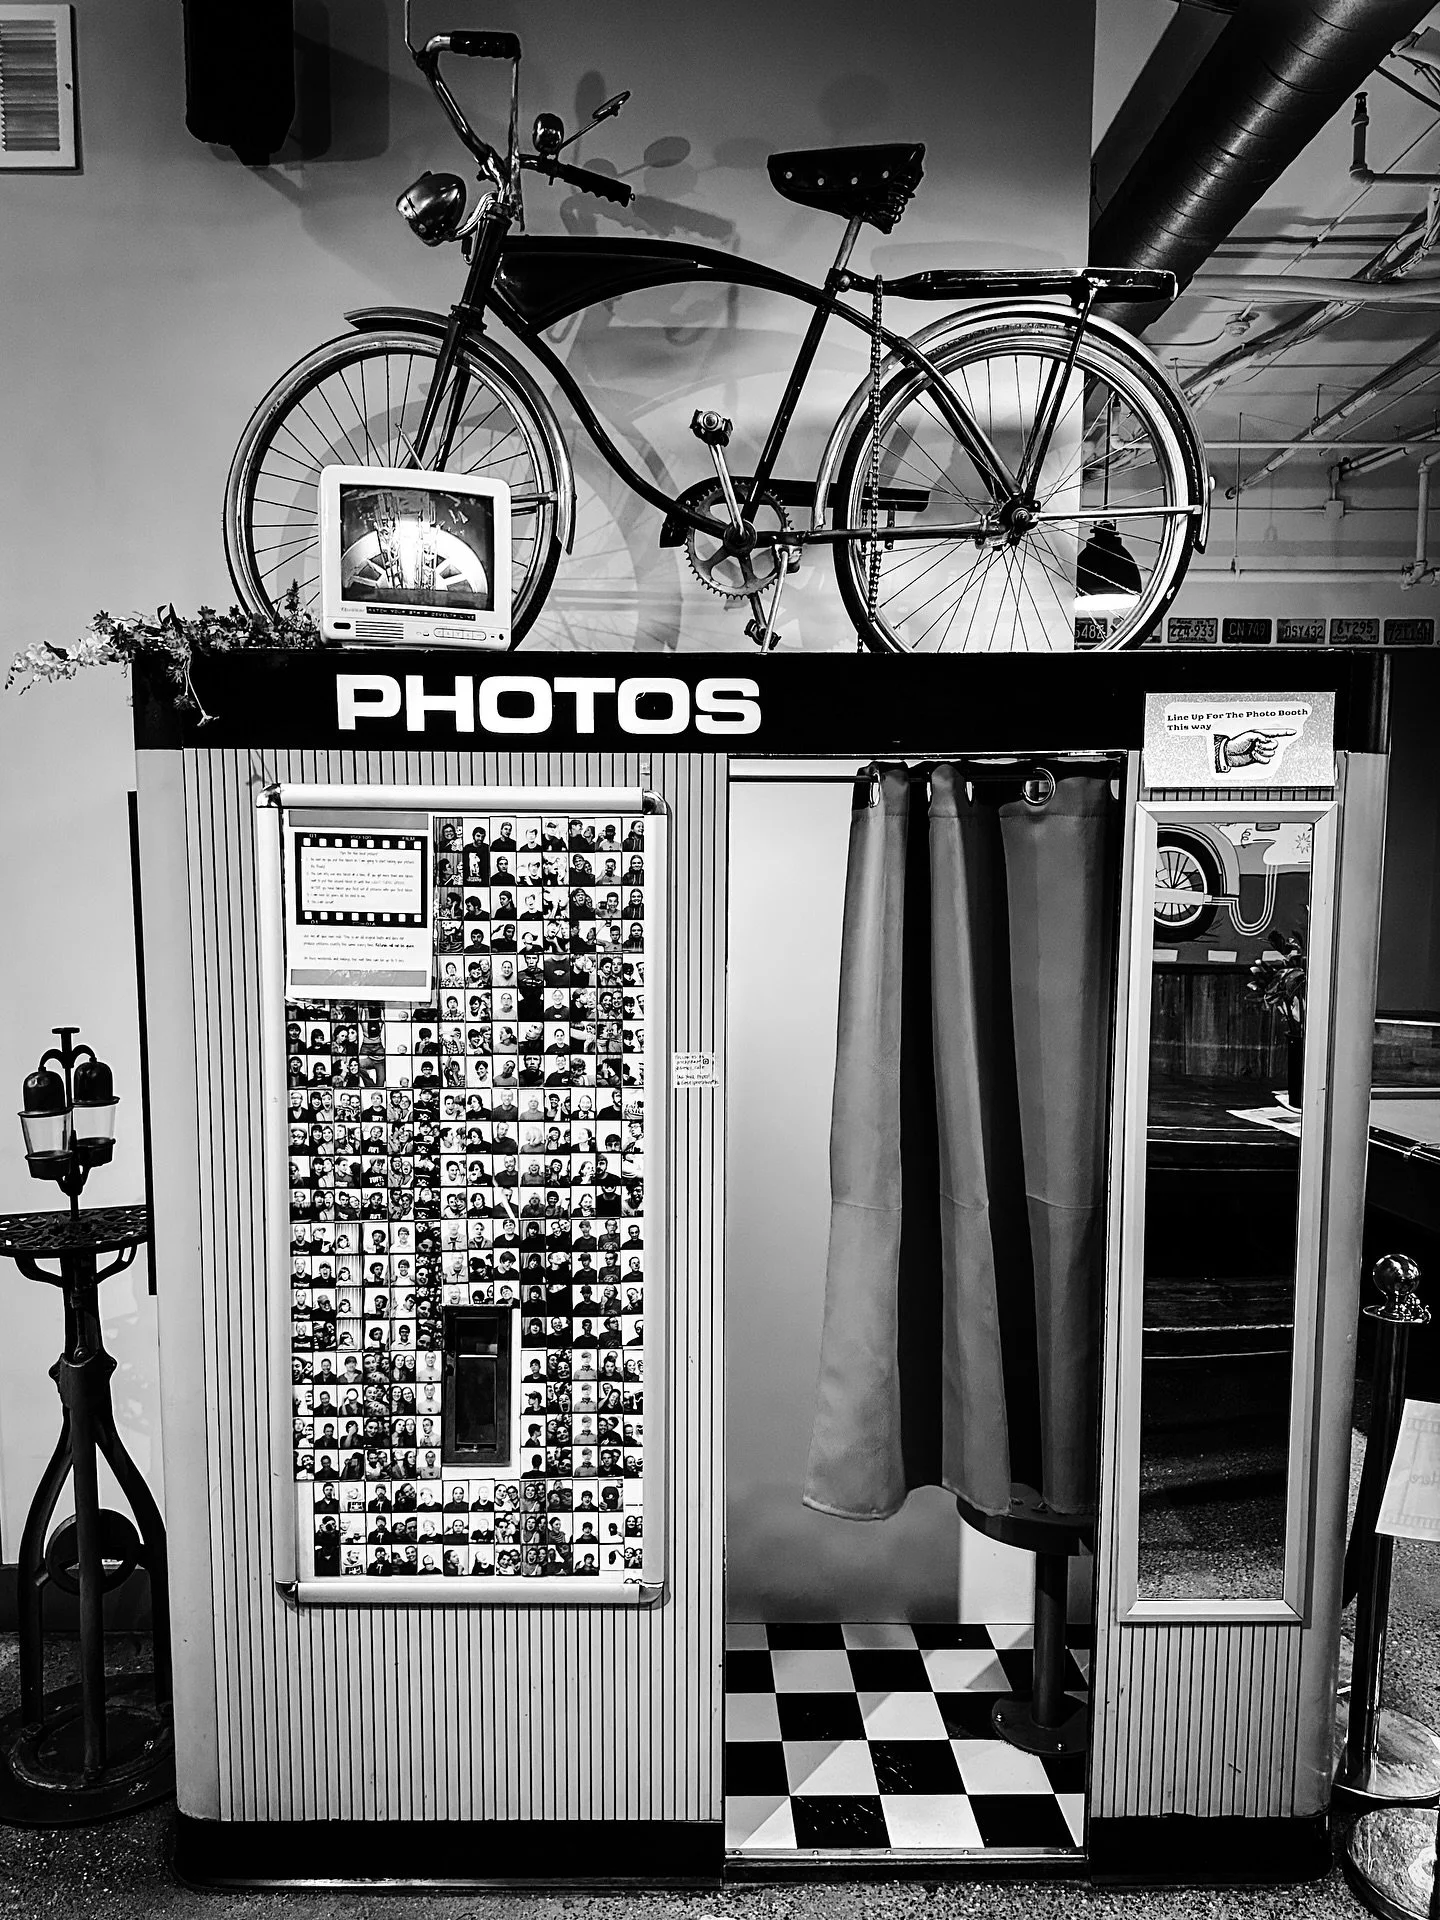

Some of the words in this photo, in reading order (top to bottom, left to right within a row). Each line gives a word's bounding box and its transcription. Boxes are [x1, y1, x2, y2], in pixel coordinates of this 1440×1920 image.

[336, 673, 762, 735] PHOTOS
[1167, 714, 1189, 722] Line
[1191, 713, 1204, 721] Up
[1226, 711, 1244, 719] The
[1246, 710, 1276, 718] Photo
[1278, 708, 1308, 717] Booth
[1167, 723, 1189, 731] This
